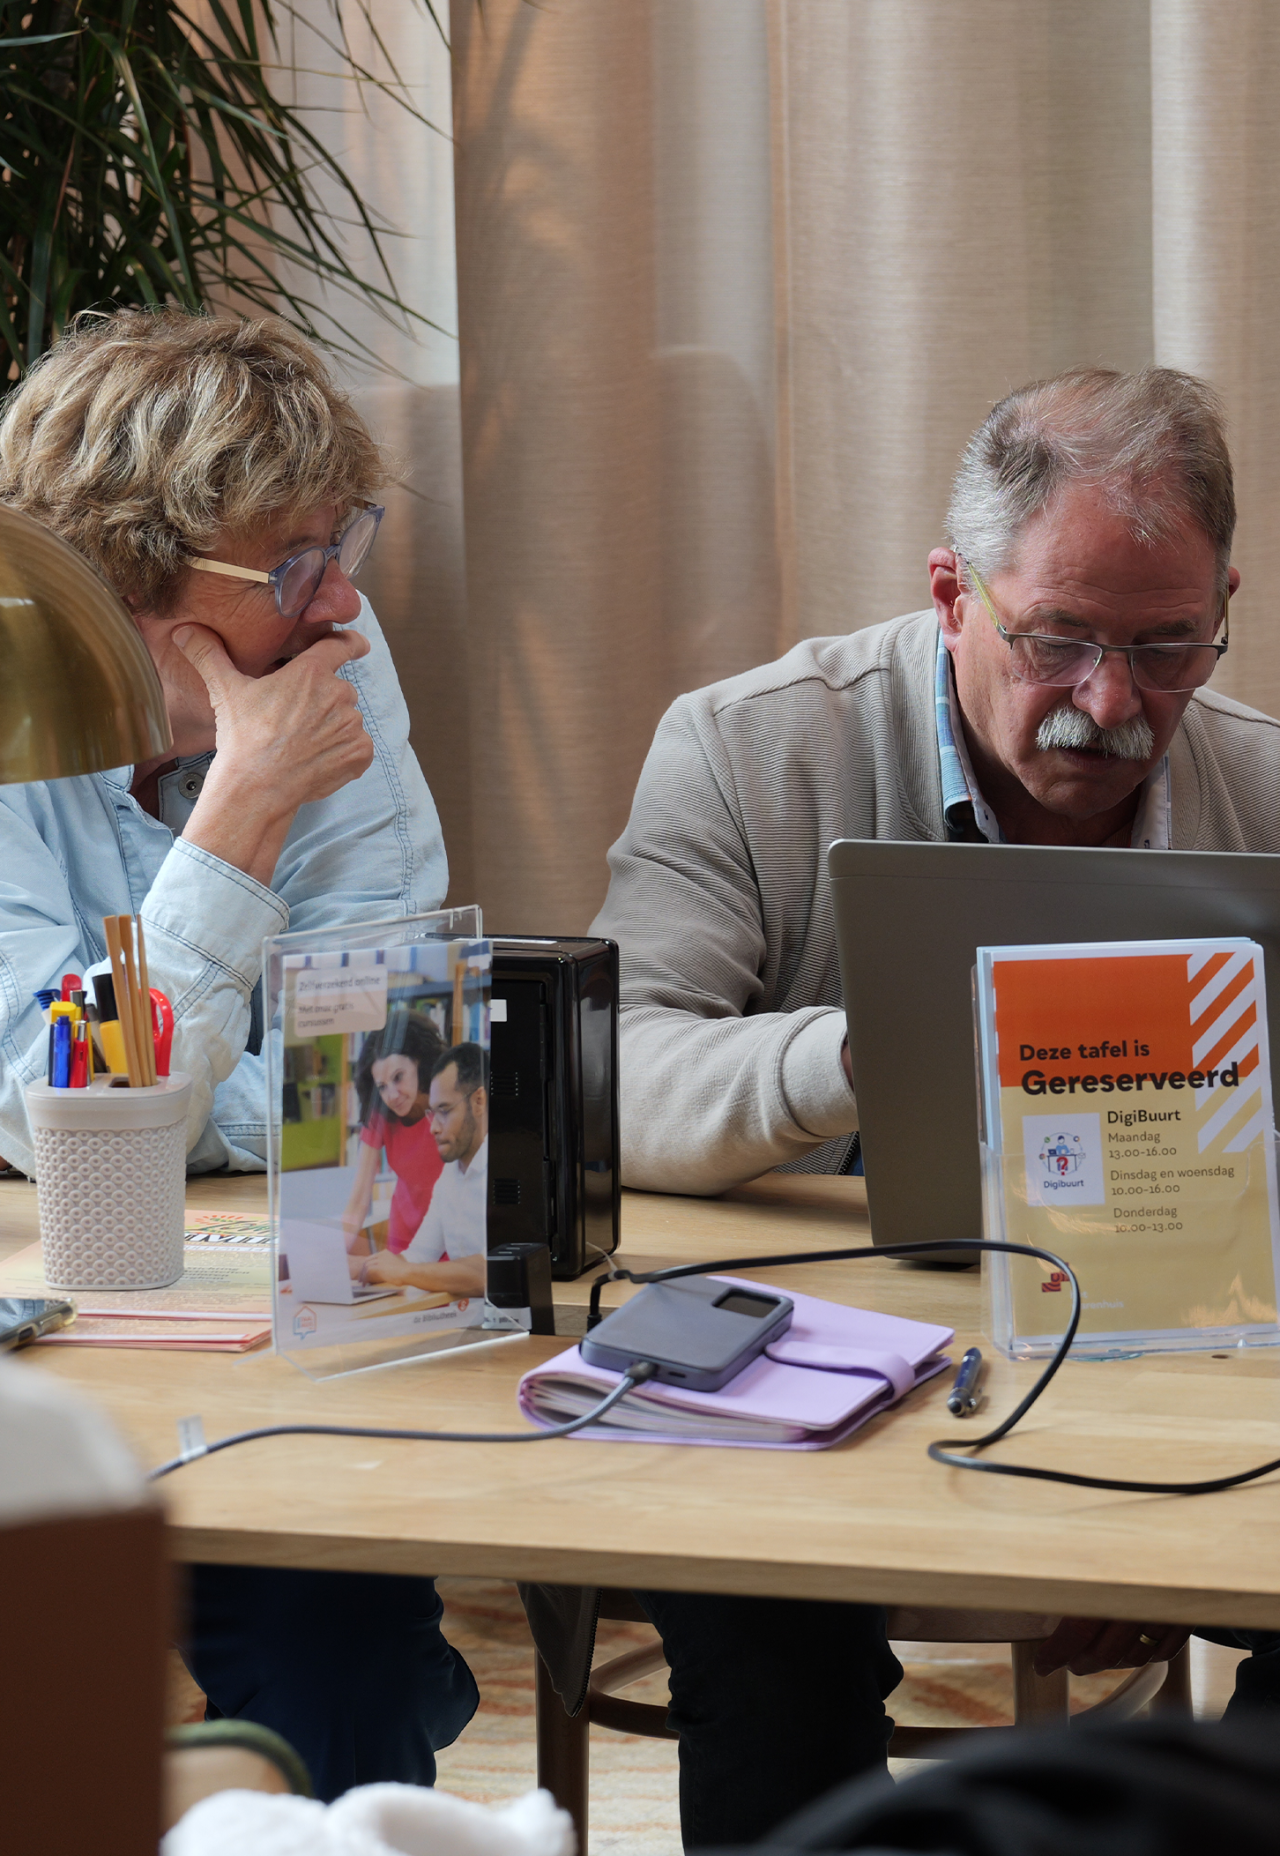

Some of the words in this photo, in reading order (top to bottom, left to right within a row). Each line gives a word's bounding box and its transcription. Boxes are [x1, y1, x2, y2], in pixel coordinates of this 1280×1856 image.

[1019, 1043, 1072, 1061] Deze
[1078, 1041, 1127, 1058] tafel
[1134, 1039, 1150, 1057] is
[1021, 1062, 1239, 1095] Gereserveerd
[1107, 1109, 1181, 1126] DigiBuurt
[1108, 1131, 1161, 1146] Maandag
[1109, 1146, 1177, 1159] 13.00-16.00
[1110, 1169, 1157, 1183] Dinsdag
[1160, 1169, 1175, 1178] en
[1178, 1165, 1234, 1179] woensdag
[1043, 1179, 1084, 1189] Digibuurt
[1111, 1184, 1180, 1196] 10.00-16.00
[1114, 1206, 1177, 1220] Donderdag
[1115, 1221, 1183, 1233] 10.00-13.00
